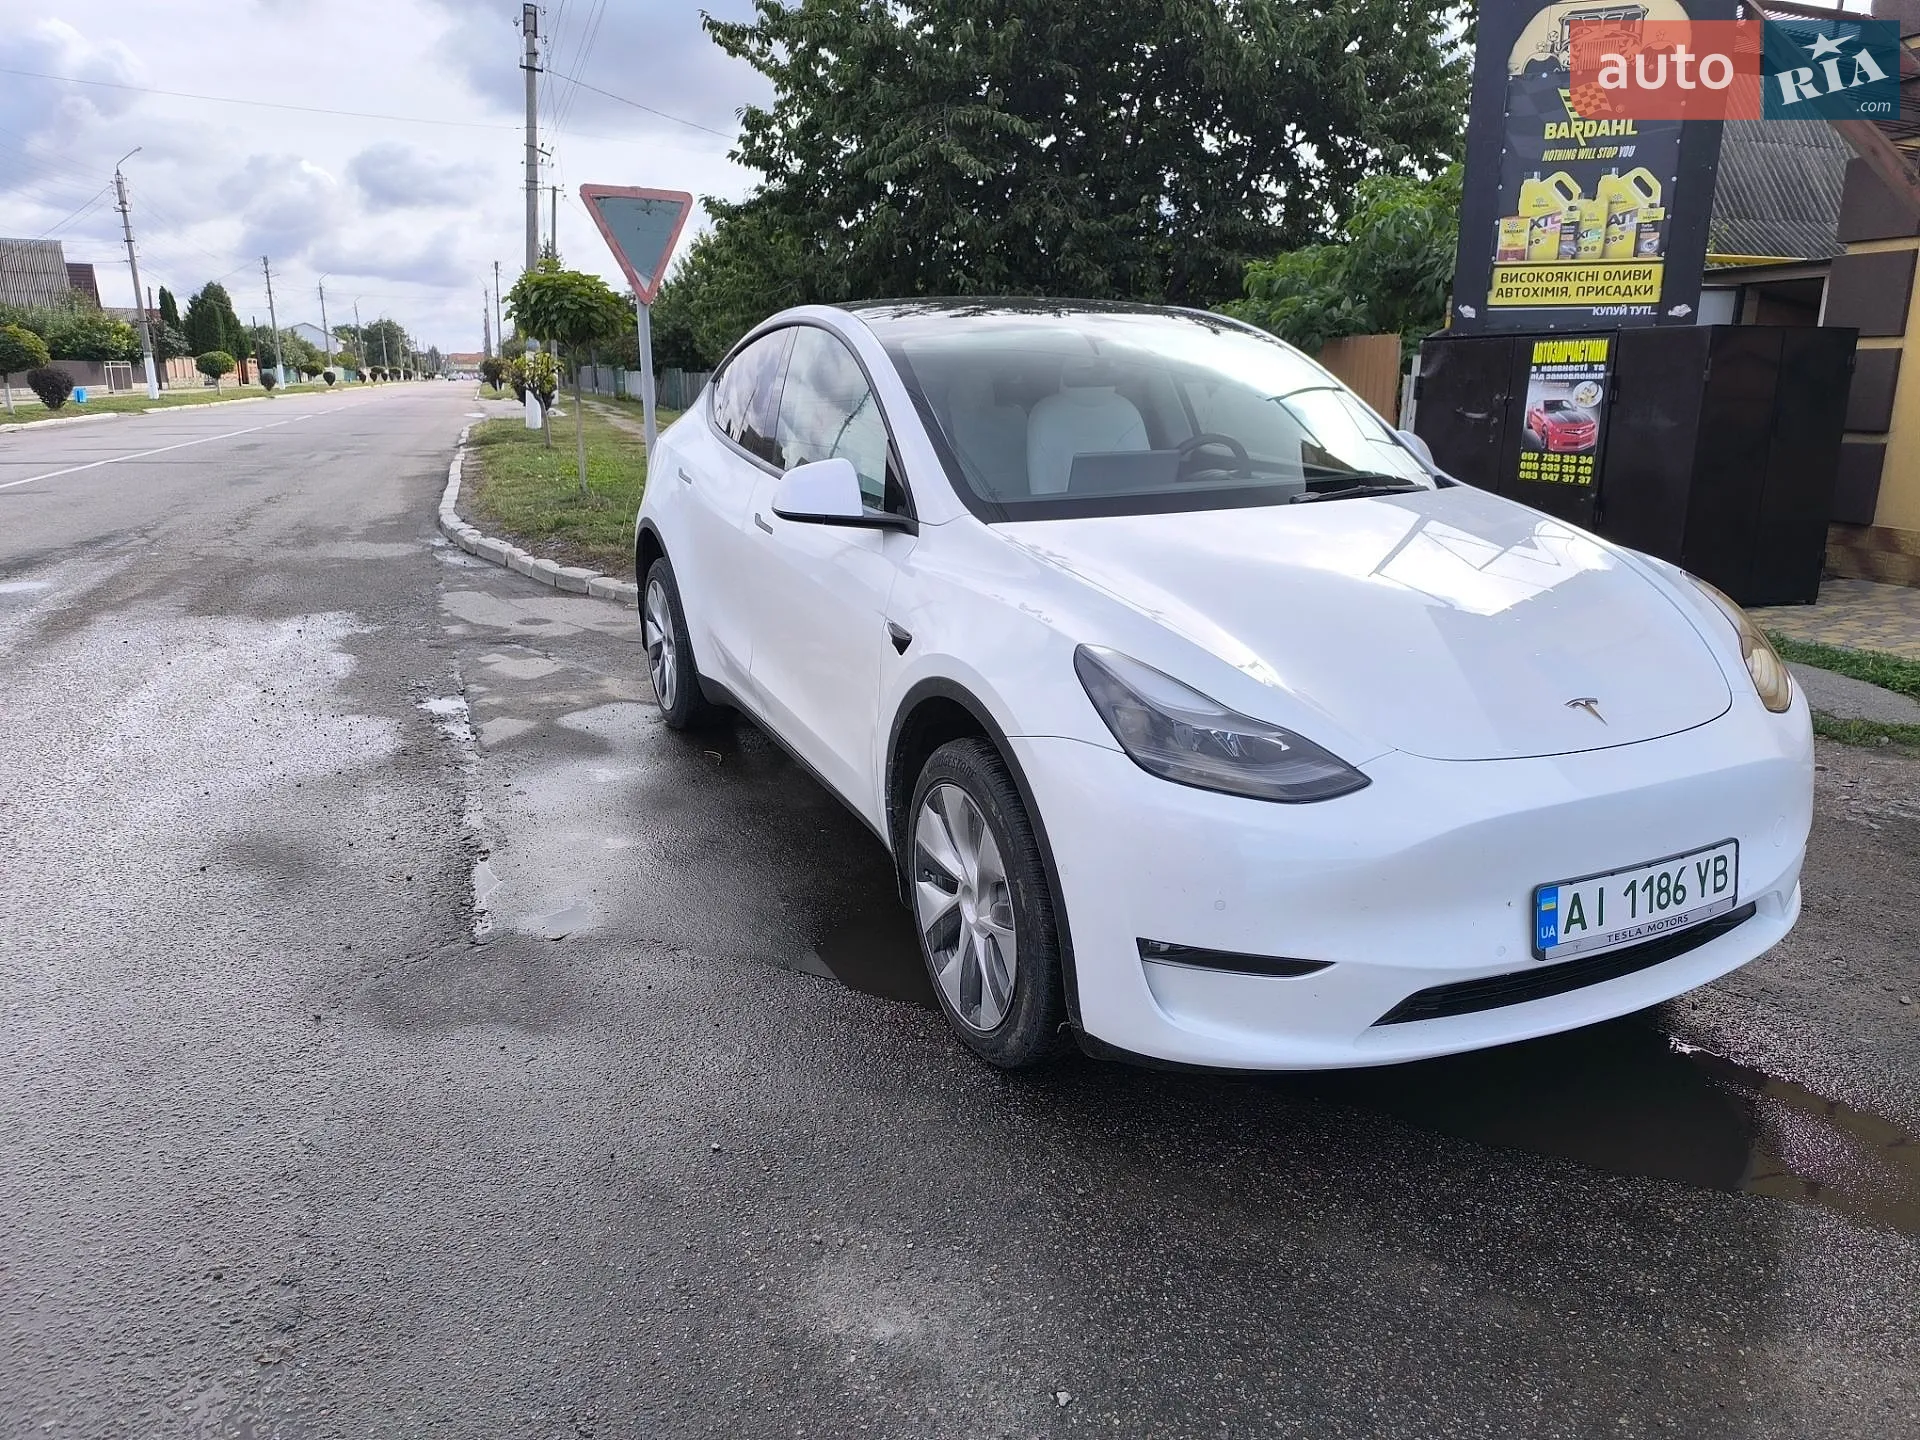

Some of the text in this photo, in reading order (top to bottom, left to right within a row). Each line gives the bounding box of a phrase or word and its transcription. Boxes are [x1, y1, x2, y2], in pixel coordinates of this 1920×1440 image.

[1544, 119, 1638, 146] BARDAHL
[1542, 145, 1637, 162] NOTHING WILL STOP YOU
[1501, 269, 1653, 283] ВИСОКОЯКІСНІ ОЛИВИ
[1496, 285, 1654, 299] АВТОХІМІЯ, ПРИСАДКИ
[1592, 304, 1627, 316] КУПУЙ
[1533, 339, 1608, 364] АВТОЗАПЧАСТИНИ
[1542, 453, 1561, 462] 733
[1562, 454, 1577, 463] 33
[1579, 455, 1593, 464] 34
[1562, 474, 1575, 483] 37
[1578, 475, 1591, 484] 37
[1564, 854, 1728, 935] AI 1186 YB
[1541, 924, 1556, 938] UA
[1606, 915, 1689, 943] TESLA MOTORS
